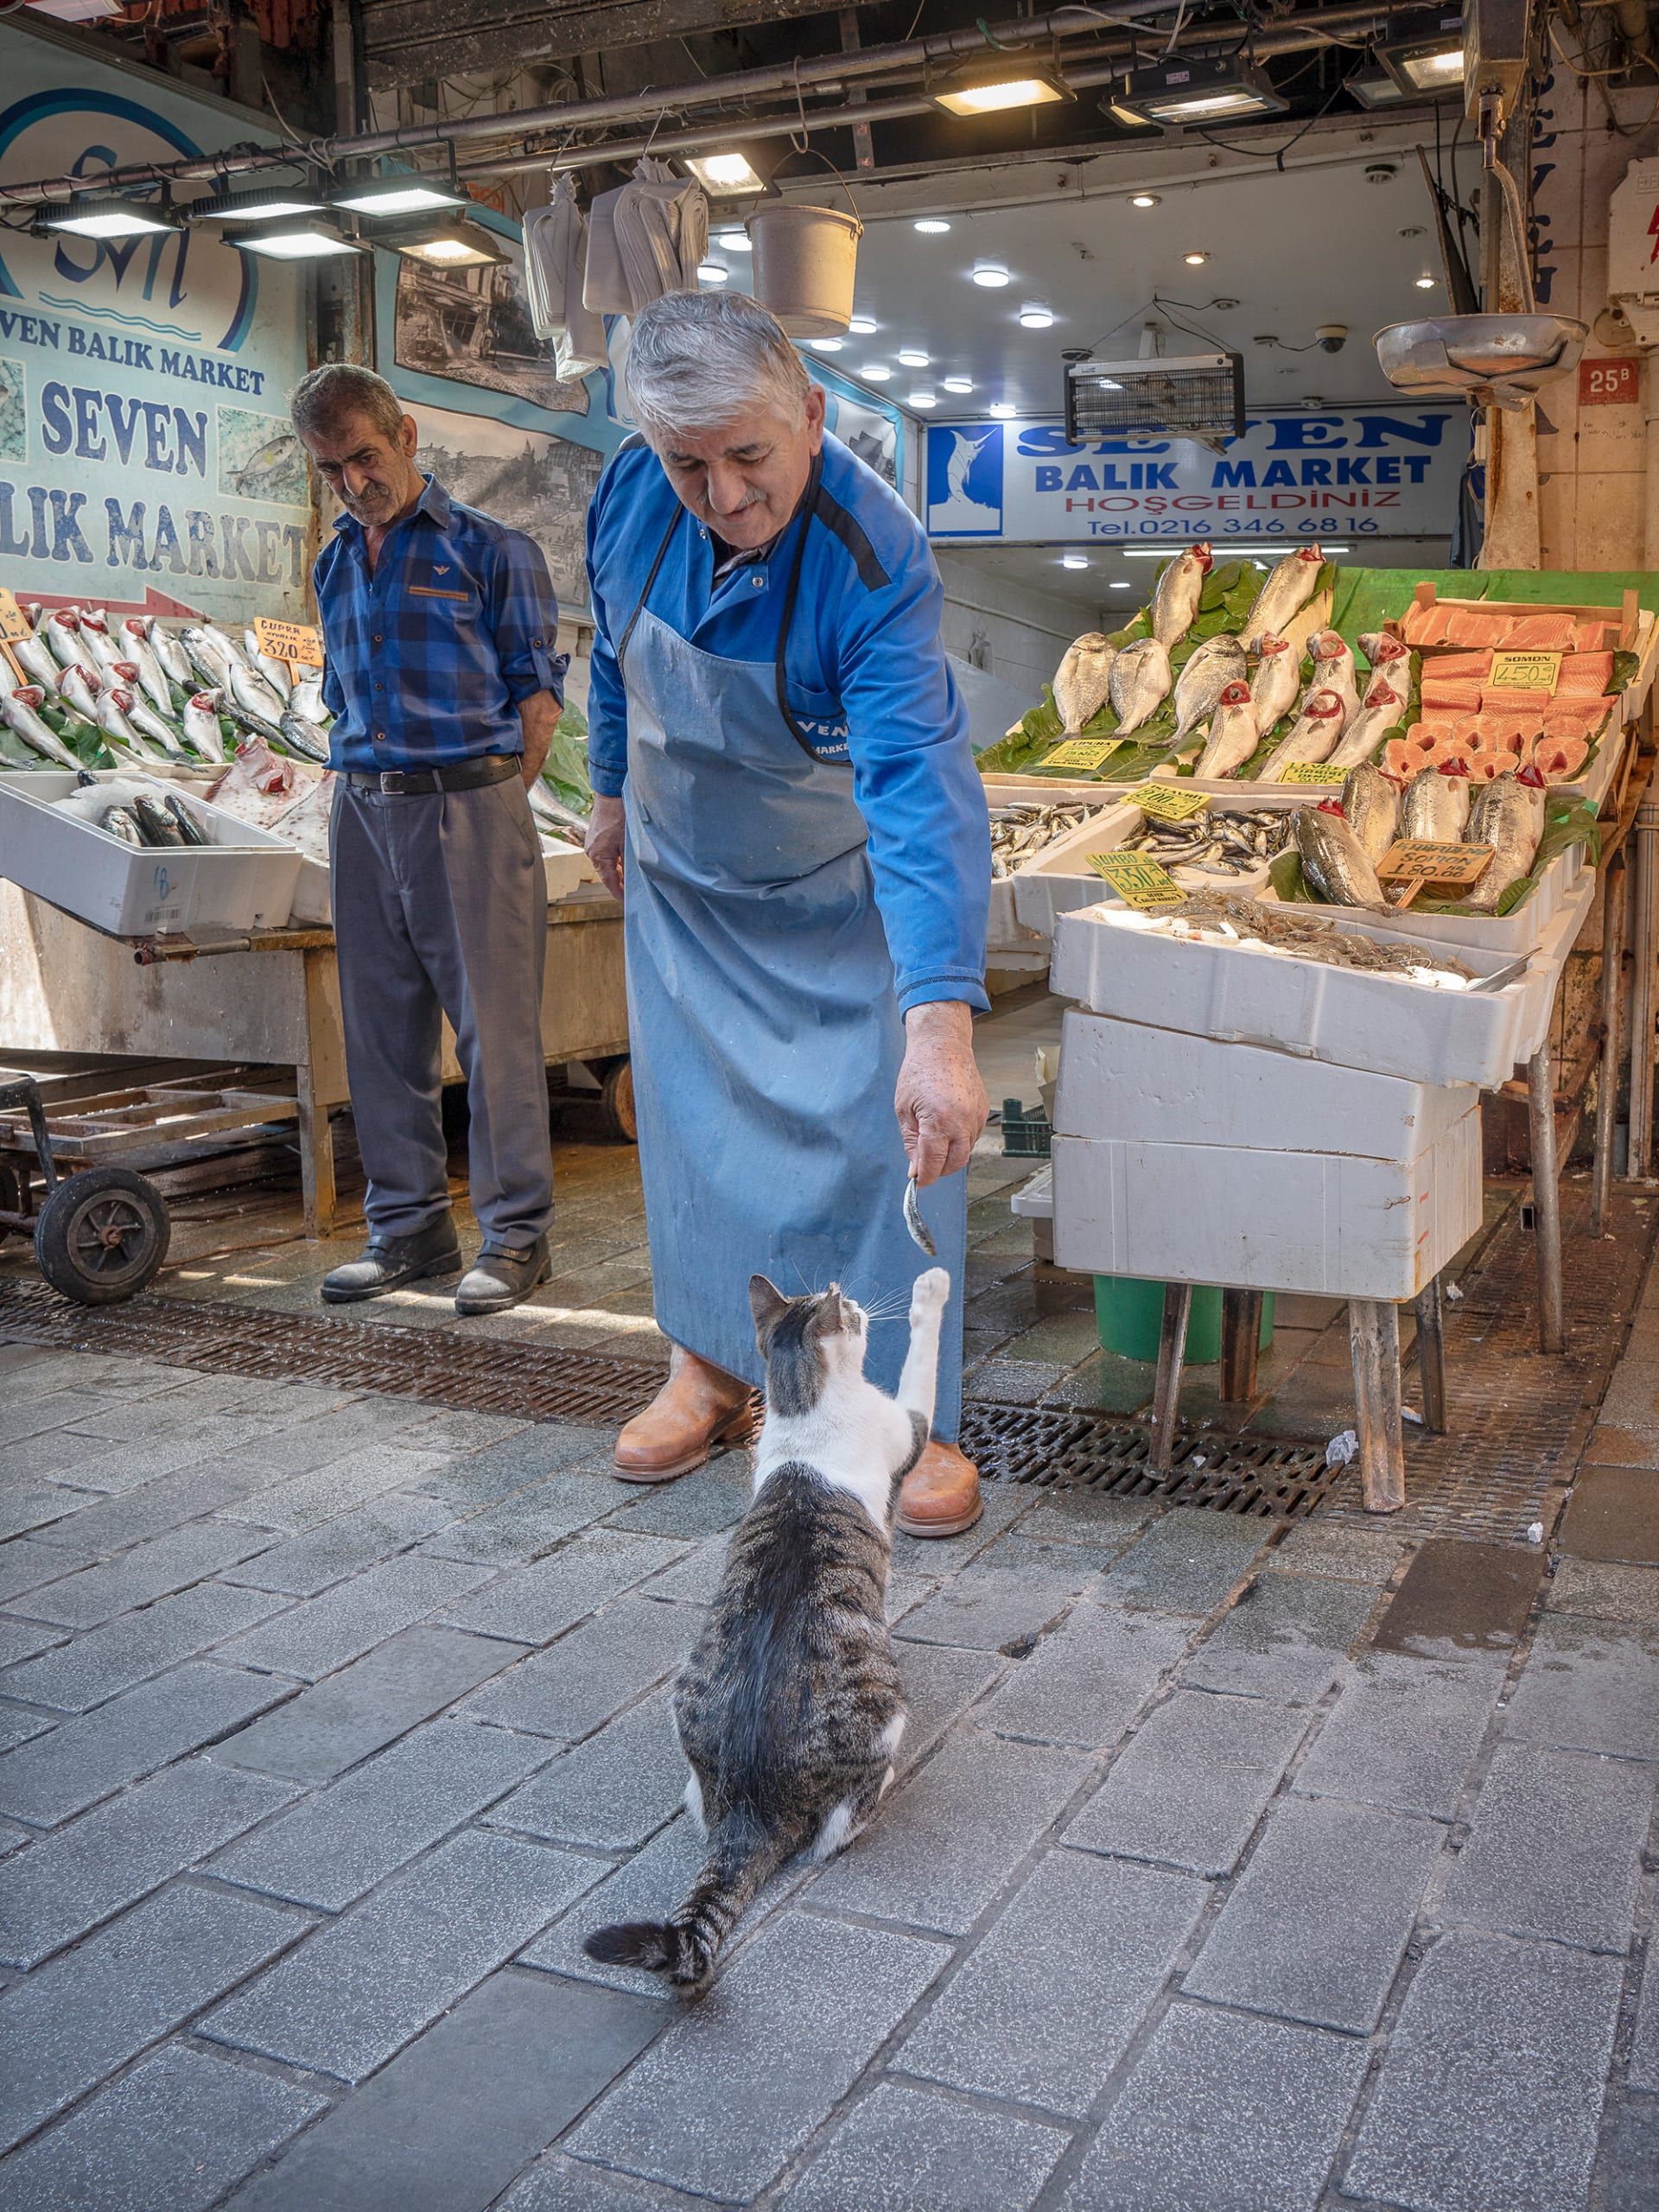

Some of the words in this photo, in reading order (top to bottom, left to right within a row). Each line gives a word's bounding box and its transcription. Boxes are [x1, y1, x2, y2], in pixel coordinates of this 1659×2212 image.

[0, 309, 61, 350] VEN
[67, 326, 155, 372] BALIK
[160, 348, 265, 396] MARKET
[42, 381, 208, 479] SEVEN
[1035, 461, 1179, 493] BALIK
[1211, 454, 1432, 489] MARKET
[1065, 489, 1402, 516] HOŞGELDİNİZ
[0, 481, 94, 563] LIK
[104, 497, 308, 588] MARKET
[1087, 518, 1211, 535] Tel.0216
[1223, 518, 1286, 534] 346
[264, 637, 298, 659] 320
[1497, 665, 1540, 681] 450
[796, 721, 849, 738] VEN
[1092, 854, 1138, 867] JUMBO
[1400, 852, 1472, 865] SOMON
